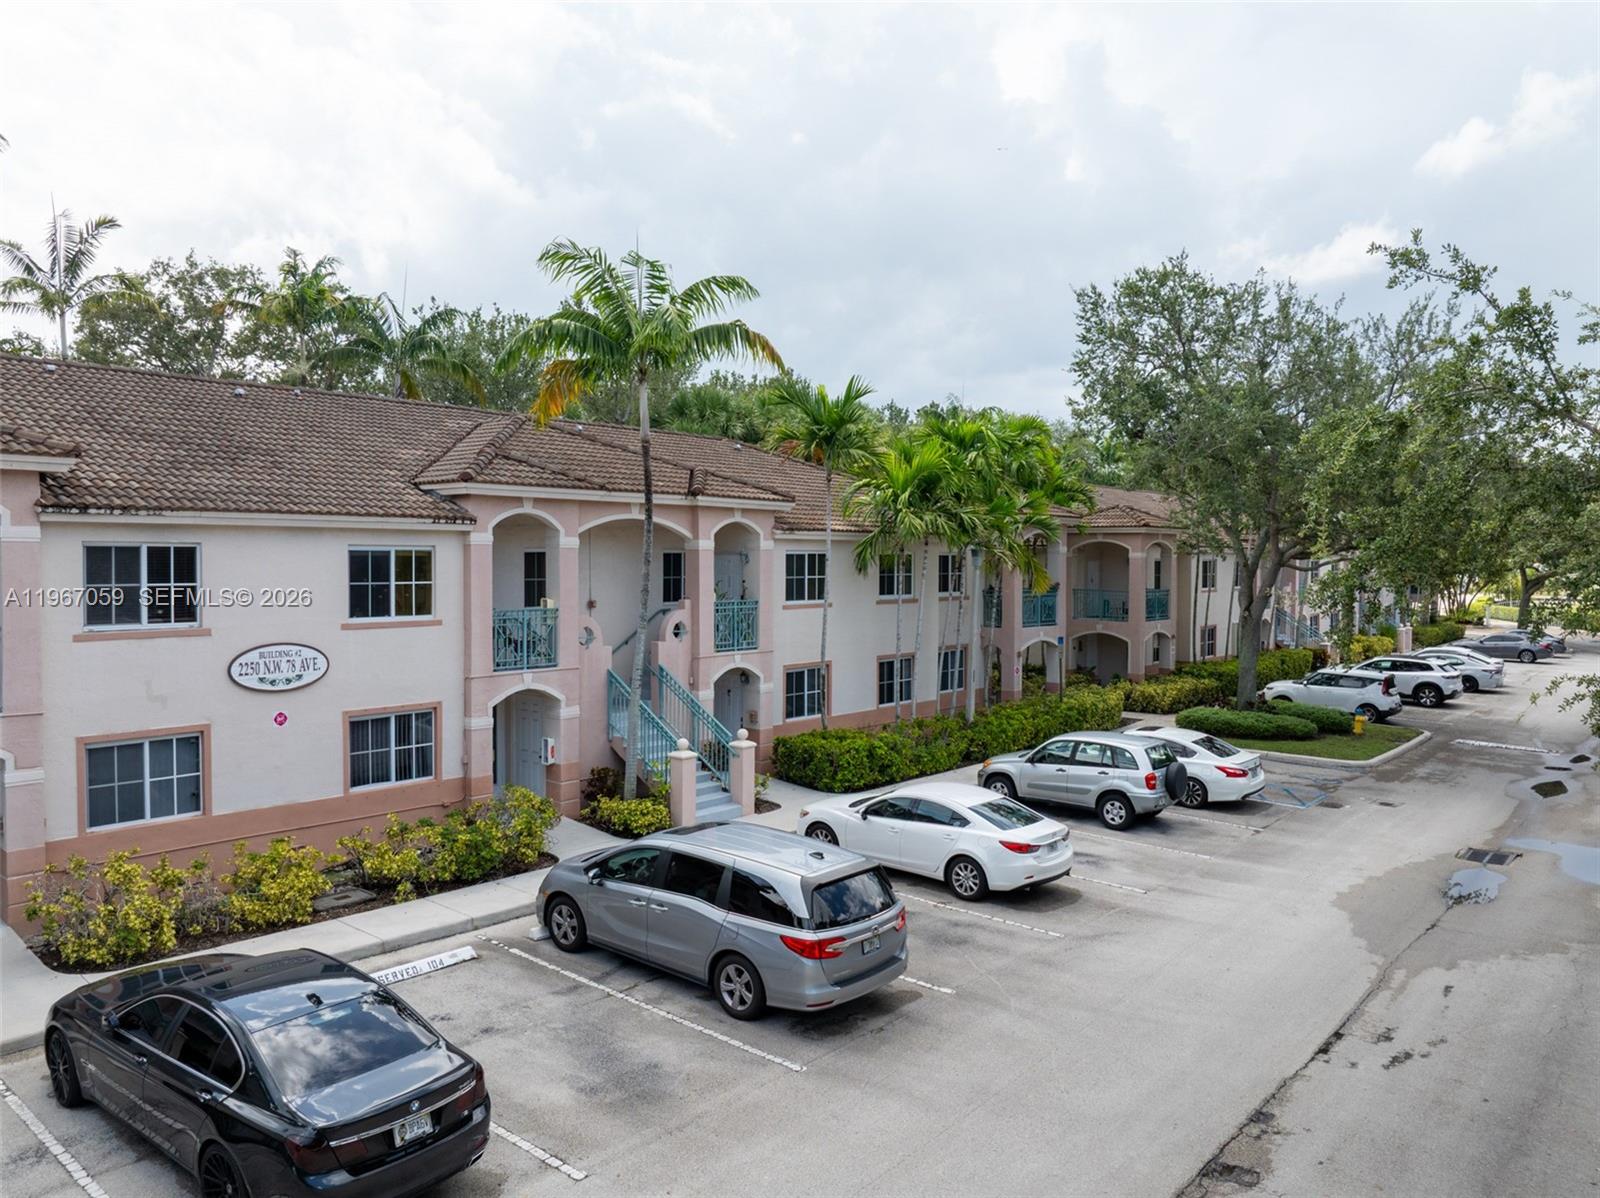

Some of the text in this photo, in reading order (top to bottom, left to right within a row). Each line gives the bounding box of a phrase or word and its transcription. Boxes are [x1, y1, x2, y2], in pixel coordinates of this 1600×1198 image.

[258, 650, 294, 659] BUILDING
[238, 657, 321, 676] 2250 N.W. 78 AVE.
[377, 965, 419, 984] SERVED
